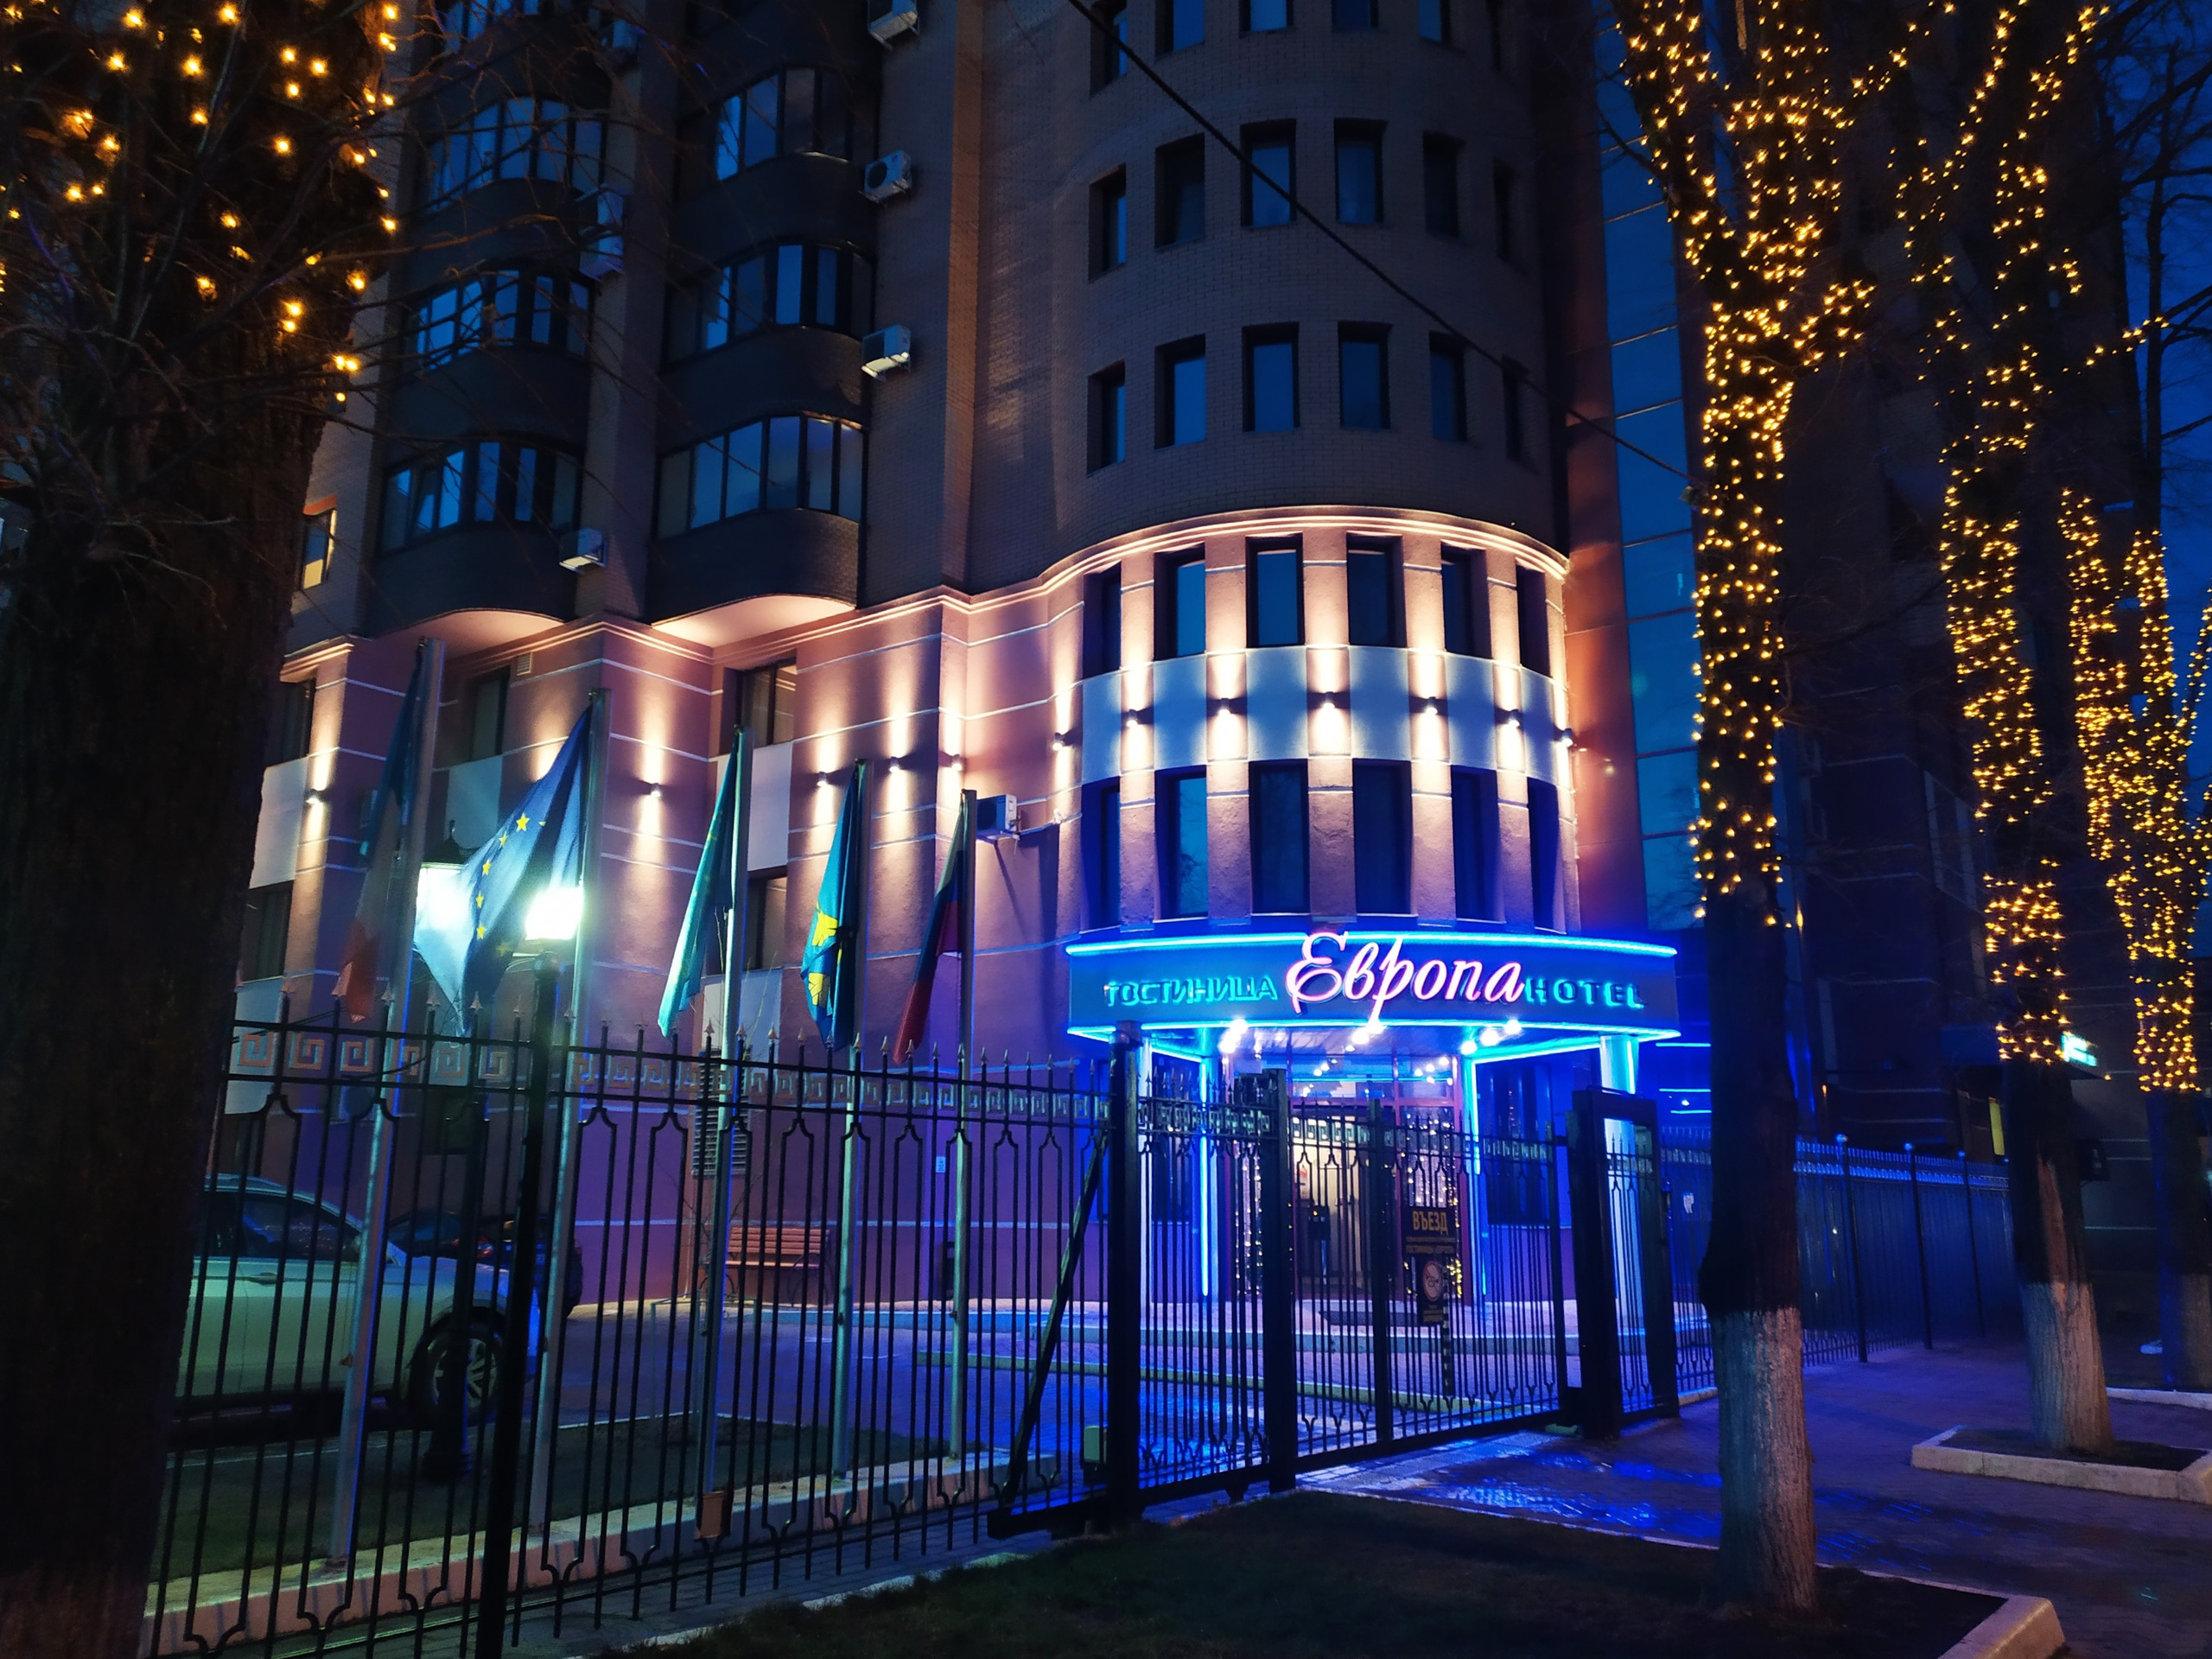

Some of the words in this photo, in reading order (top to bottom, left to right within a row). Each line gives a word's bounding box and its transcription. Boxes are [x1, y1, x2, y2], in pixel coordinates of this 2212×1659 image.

[1104, 975, 1279, 1007] ГОСТИНИЦА
[1285, 931, 1526, 1025] Европа
[1525, 978, 1648, 1008] HOTEL
[1412, 1211, 1449, 1236] ВЪЕЗД
